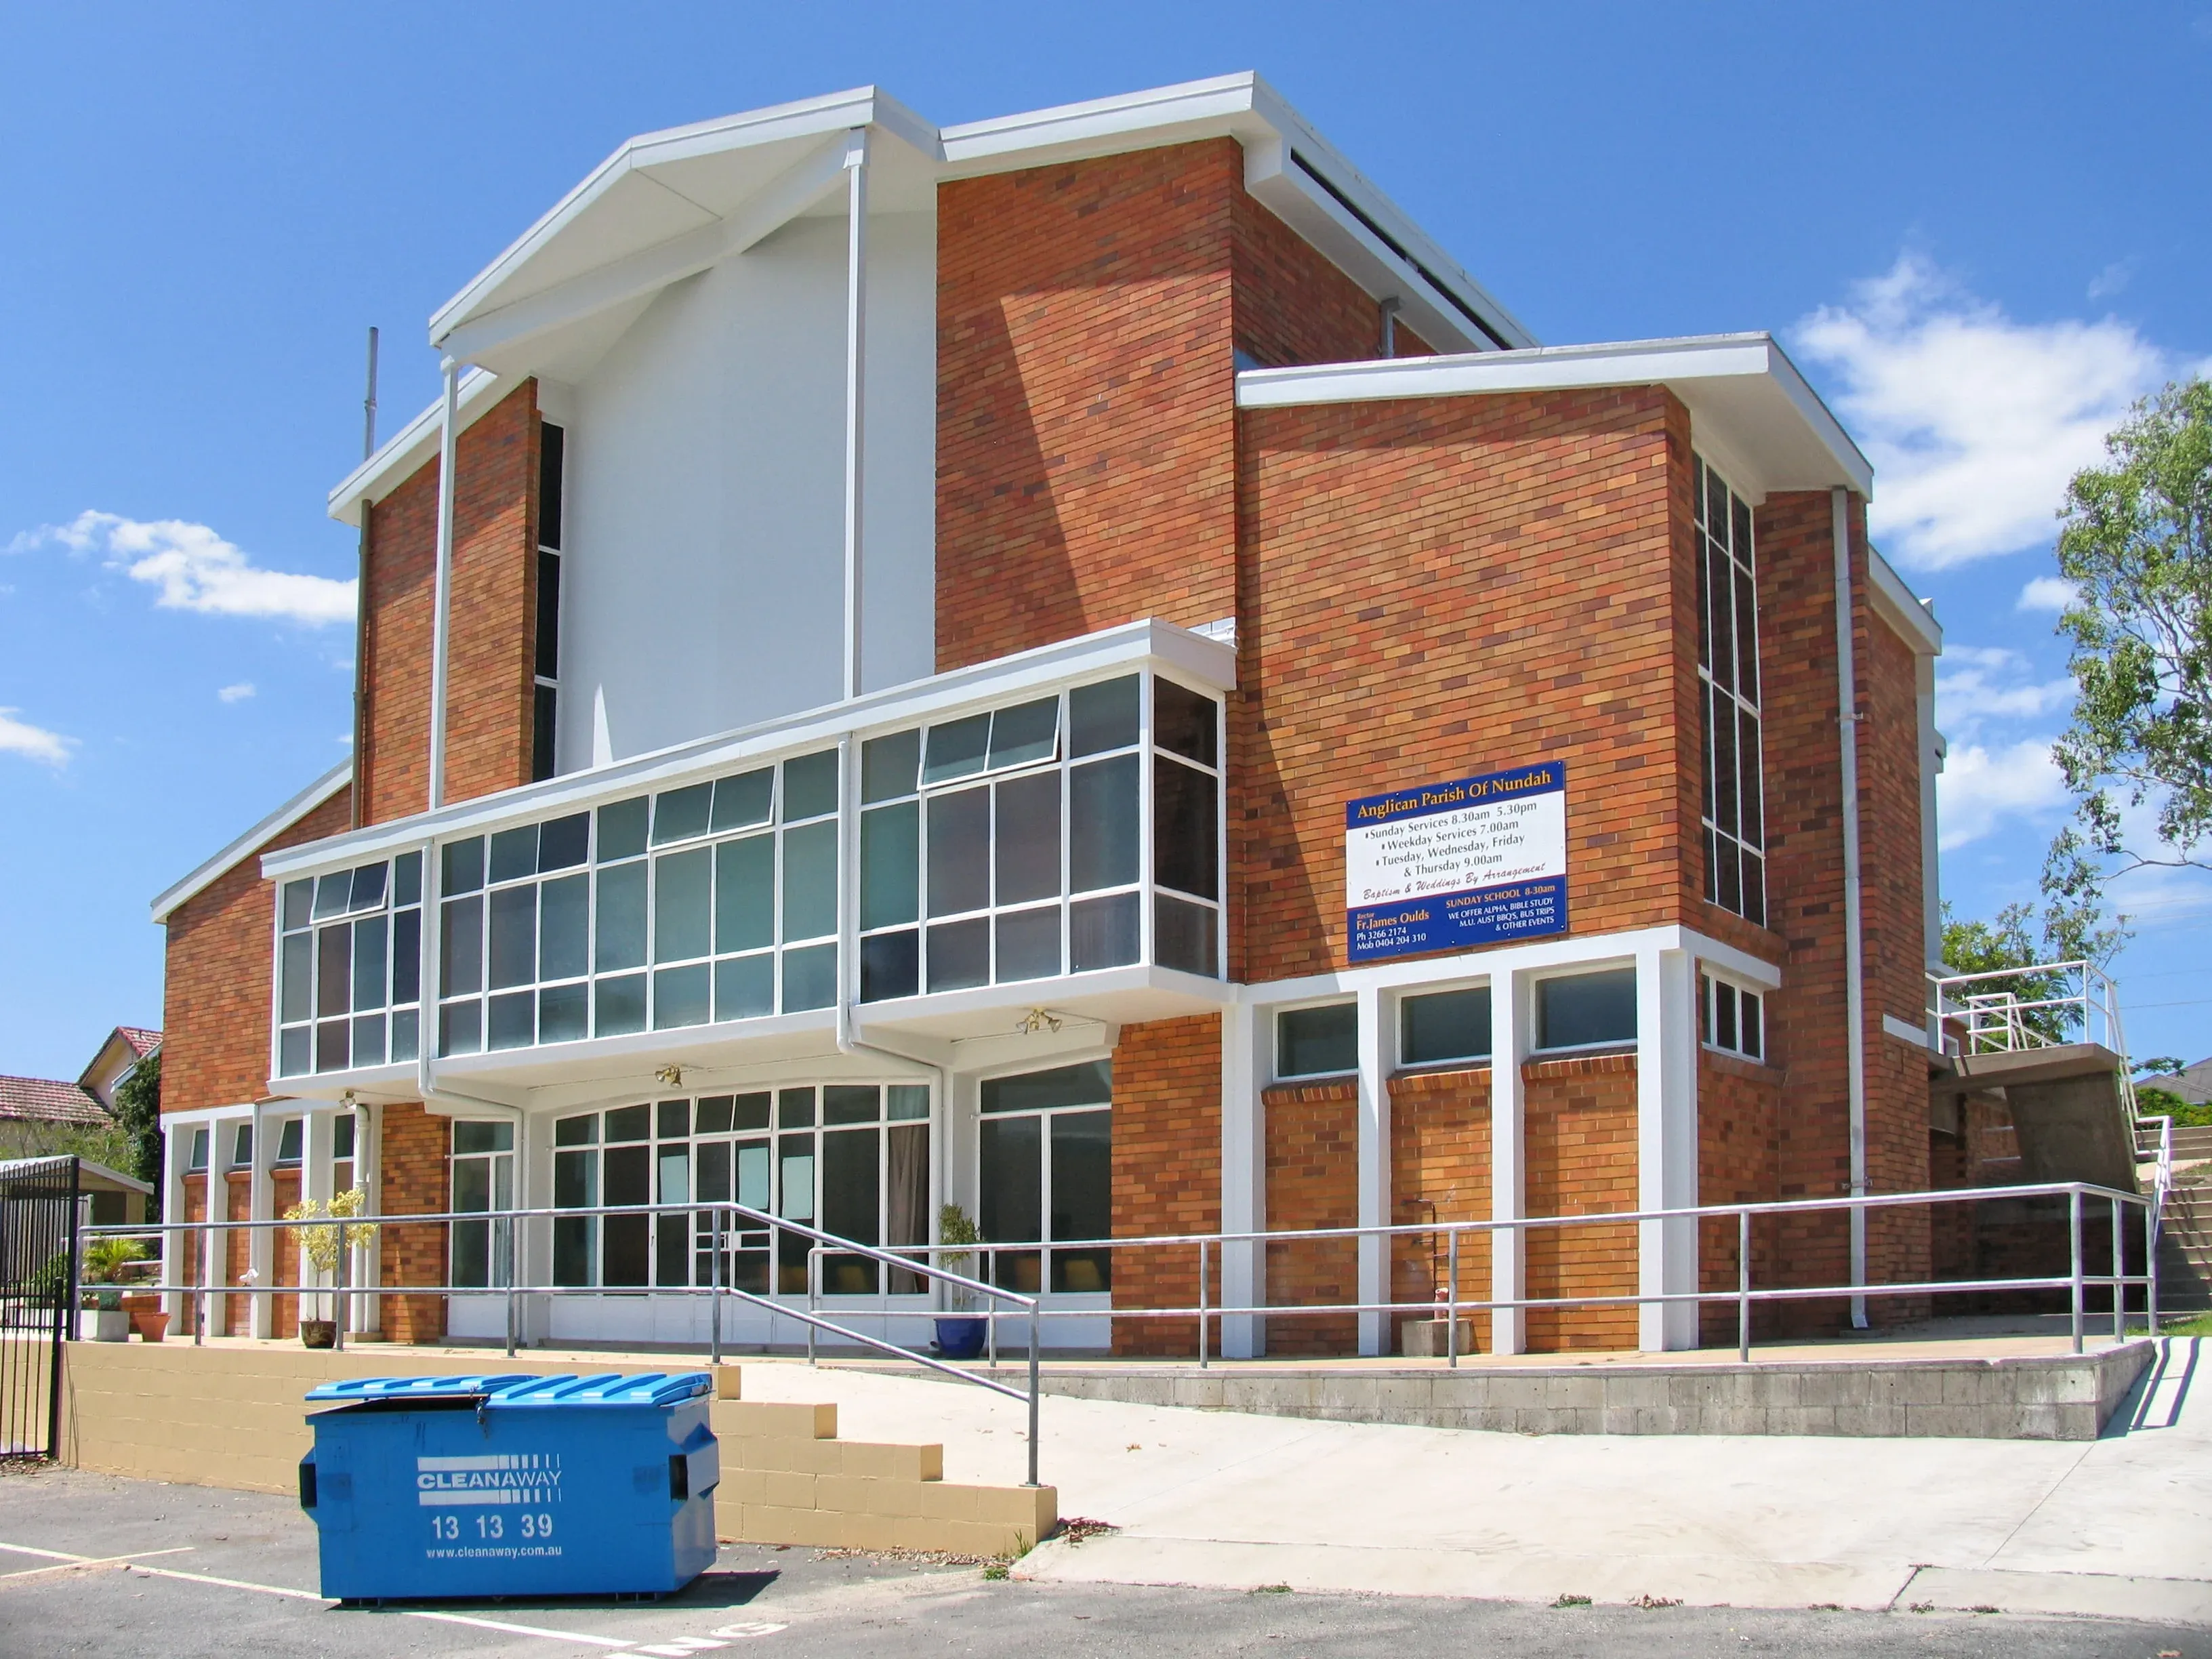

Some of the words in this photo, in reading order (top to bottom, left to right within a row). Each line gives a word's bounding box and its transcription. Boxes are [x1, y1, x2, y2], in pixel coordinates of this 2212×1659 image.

[1357, 798, 1418, 819] Anglican
[1422, 787, 1465, 807] Parish
[1469, 781, 1489, 798] Of
[1492, 770, 1551, 794] Nundah
[1370, 825, 1405, 840] Sunday
[1408, 817, 1448, 833] Services
[1452, 811, 1490, 825] 8.30am
[1497, 801, 1537, 817] 5.30pm
[1387, 835, 1433, 851] Weekday
[1436, 827, 1477, 842] Services
[1480, 820, 1519, 836] 7.00am
[1382, 849, 1425, 866] Tuesday,
[1428, 839, 1490, 858] Wednesday,
[1492, 833, 1525, 848] Friday
[1404, 869, 1412, 877] &
[1415, 859, 1461, 876] Thursday
[1464, 853, 1502, 867] 9.00am
[1363, 888, 1400, 901] Baptism
[1405, 882, 1412, 893] &
[1416, 878, 1460, 890] Weddings
[1465, 872, 1479, 884] By
[1483, 862, 1546, 881] Arrangement
[1446, 895, 1482, 909] SUNDAY
[1484, 889, 1521, 902] SCHOOL
[1525, 884, 1555, 895] 8.30am
[1460, 907, 1482, 918] OFFER
[1510, 901, 1529, 910] BIBLE
[1530, 897, 1554, 907] STUDY
[1400, 909, 1430, 923] Oulds
[1477, 915, 1495, 924] AUST
[1520, 909, 1535, 918] BUS
[1536, 906, 1555, 916] TRIPS
[1502, 920, 1527, 930] OTHER
[1528, 916, 1555, 926] EVENTS
[1357, 932, 1366, 941] Ph
[1368, 929, 1386, 939] 3266
[1389, 926, 1407, 937] 2174
[1357, 940, 1374, 950] Mob
[1375, 937, 1393, 947] 0404
[1396, 935, 1410, 945] 204
[1412, 933, 1427, 942] 310
[417, 1471, 562, 1489] CLEANAWAY
[432, 1516, 459, 1539] 13
[476, 1515, 504, 1538] 13
[521, 1513, 553, 1538] 39
[426, 1546, 562, 1559] www.cleanaway.com.au
